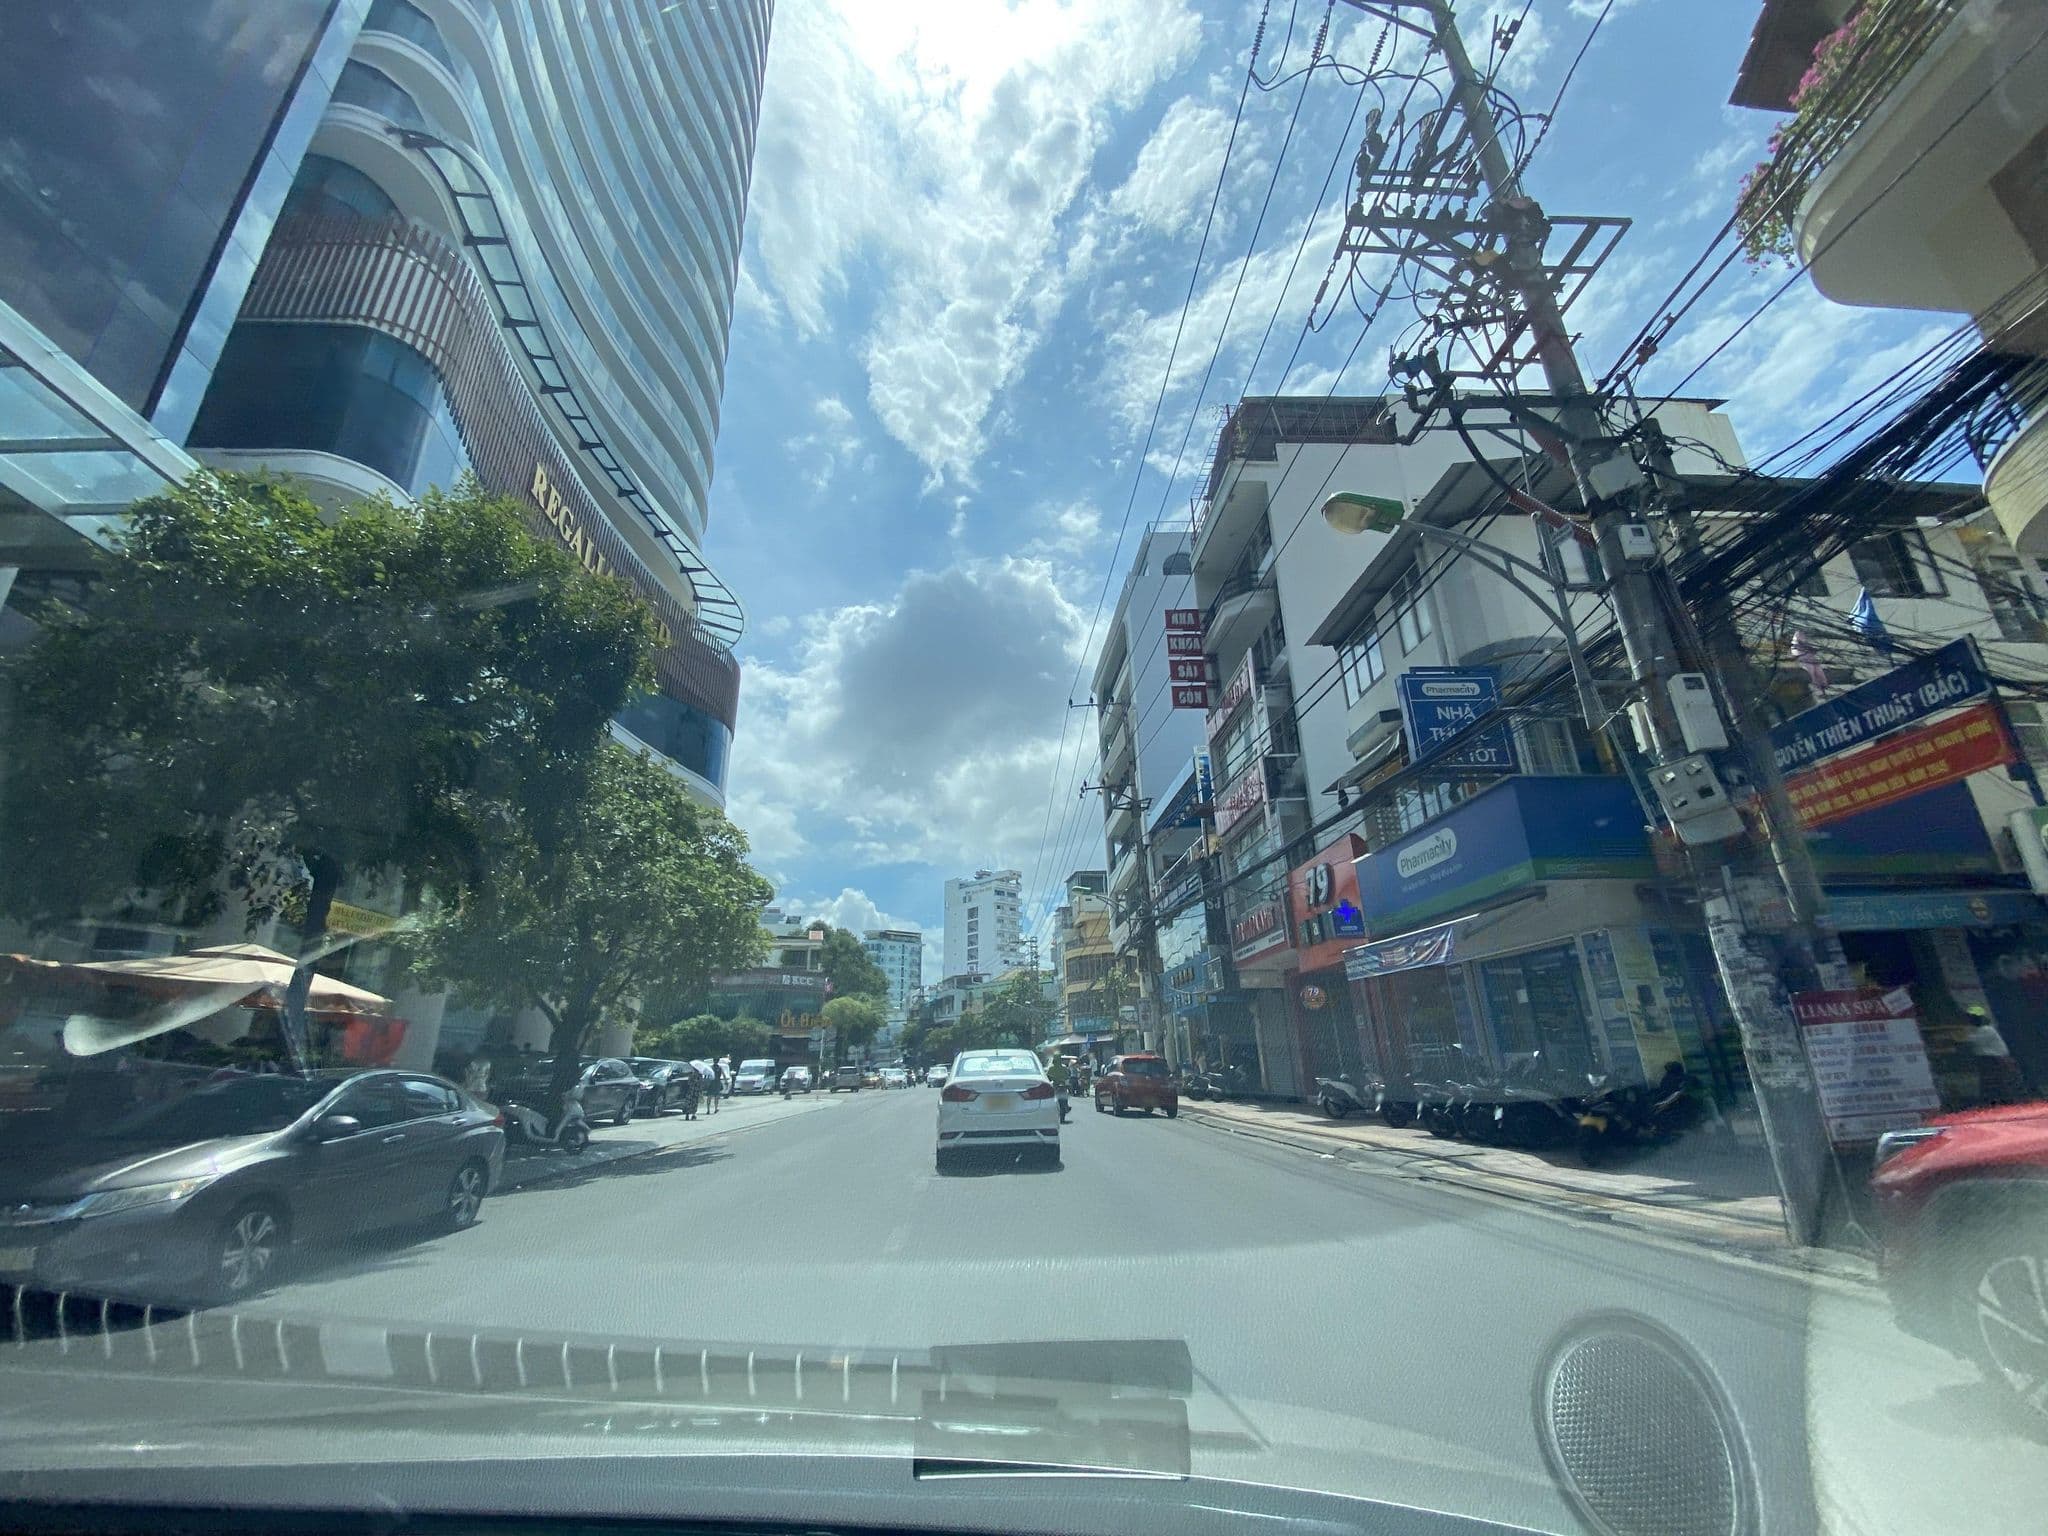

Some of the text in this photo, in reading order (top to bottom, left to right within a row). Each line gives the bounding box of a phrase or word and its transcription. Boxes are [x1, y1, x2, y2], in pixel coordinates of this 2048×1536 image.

[1425, 684, 1476, 695] Pharmacity
[1774, 731, 1817, 768] GUYỄN
[1400, 837, 1452, 873] Pharmacity
[1305, 863, 1329, 905] 79
